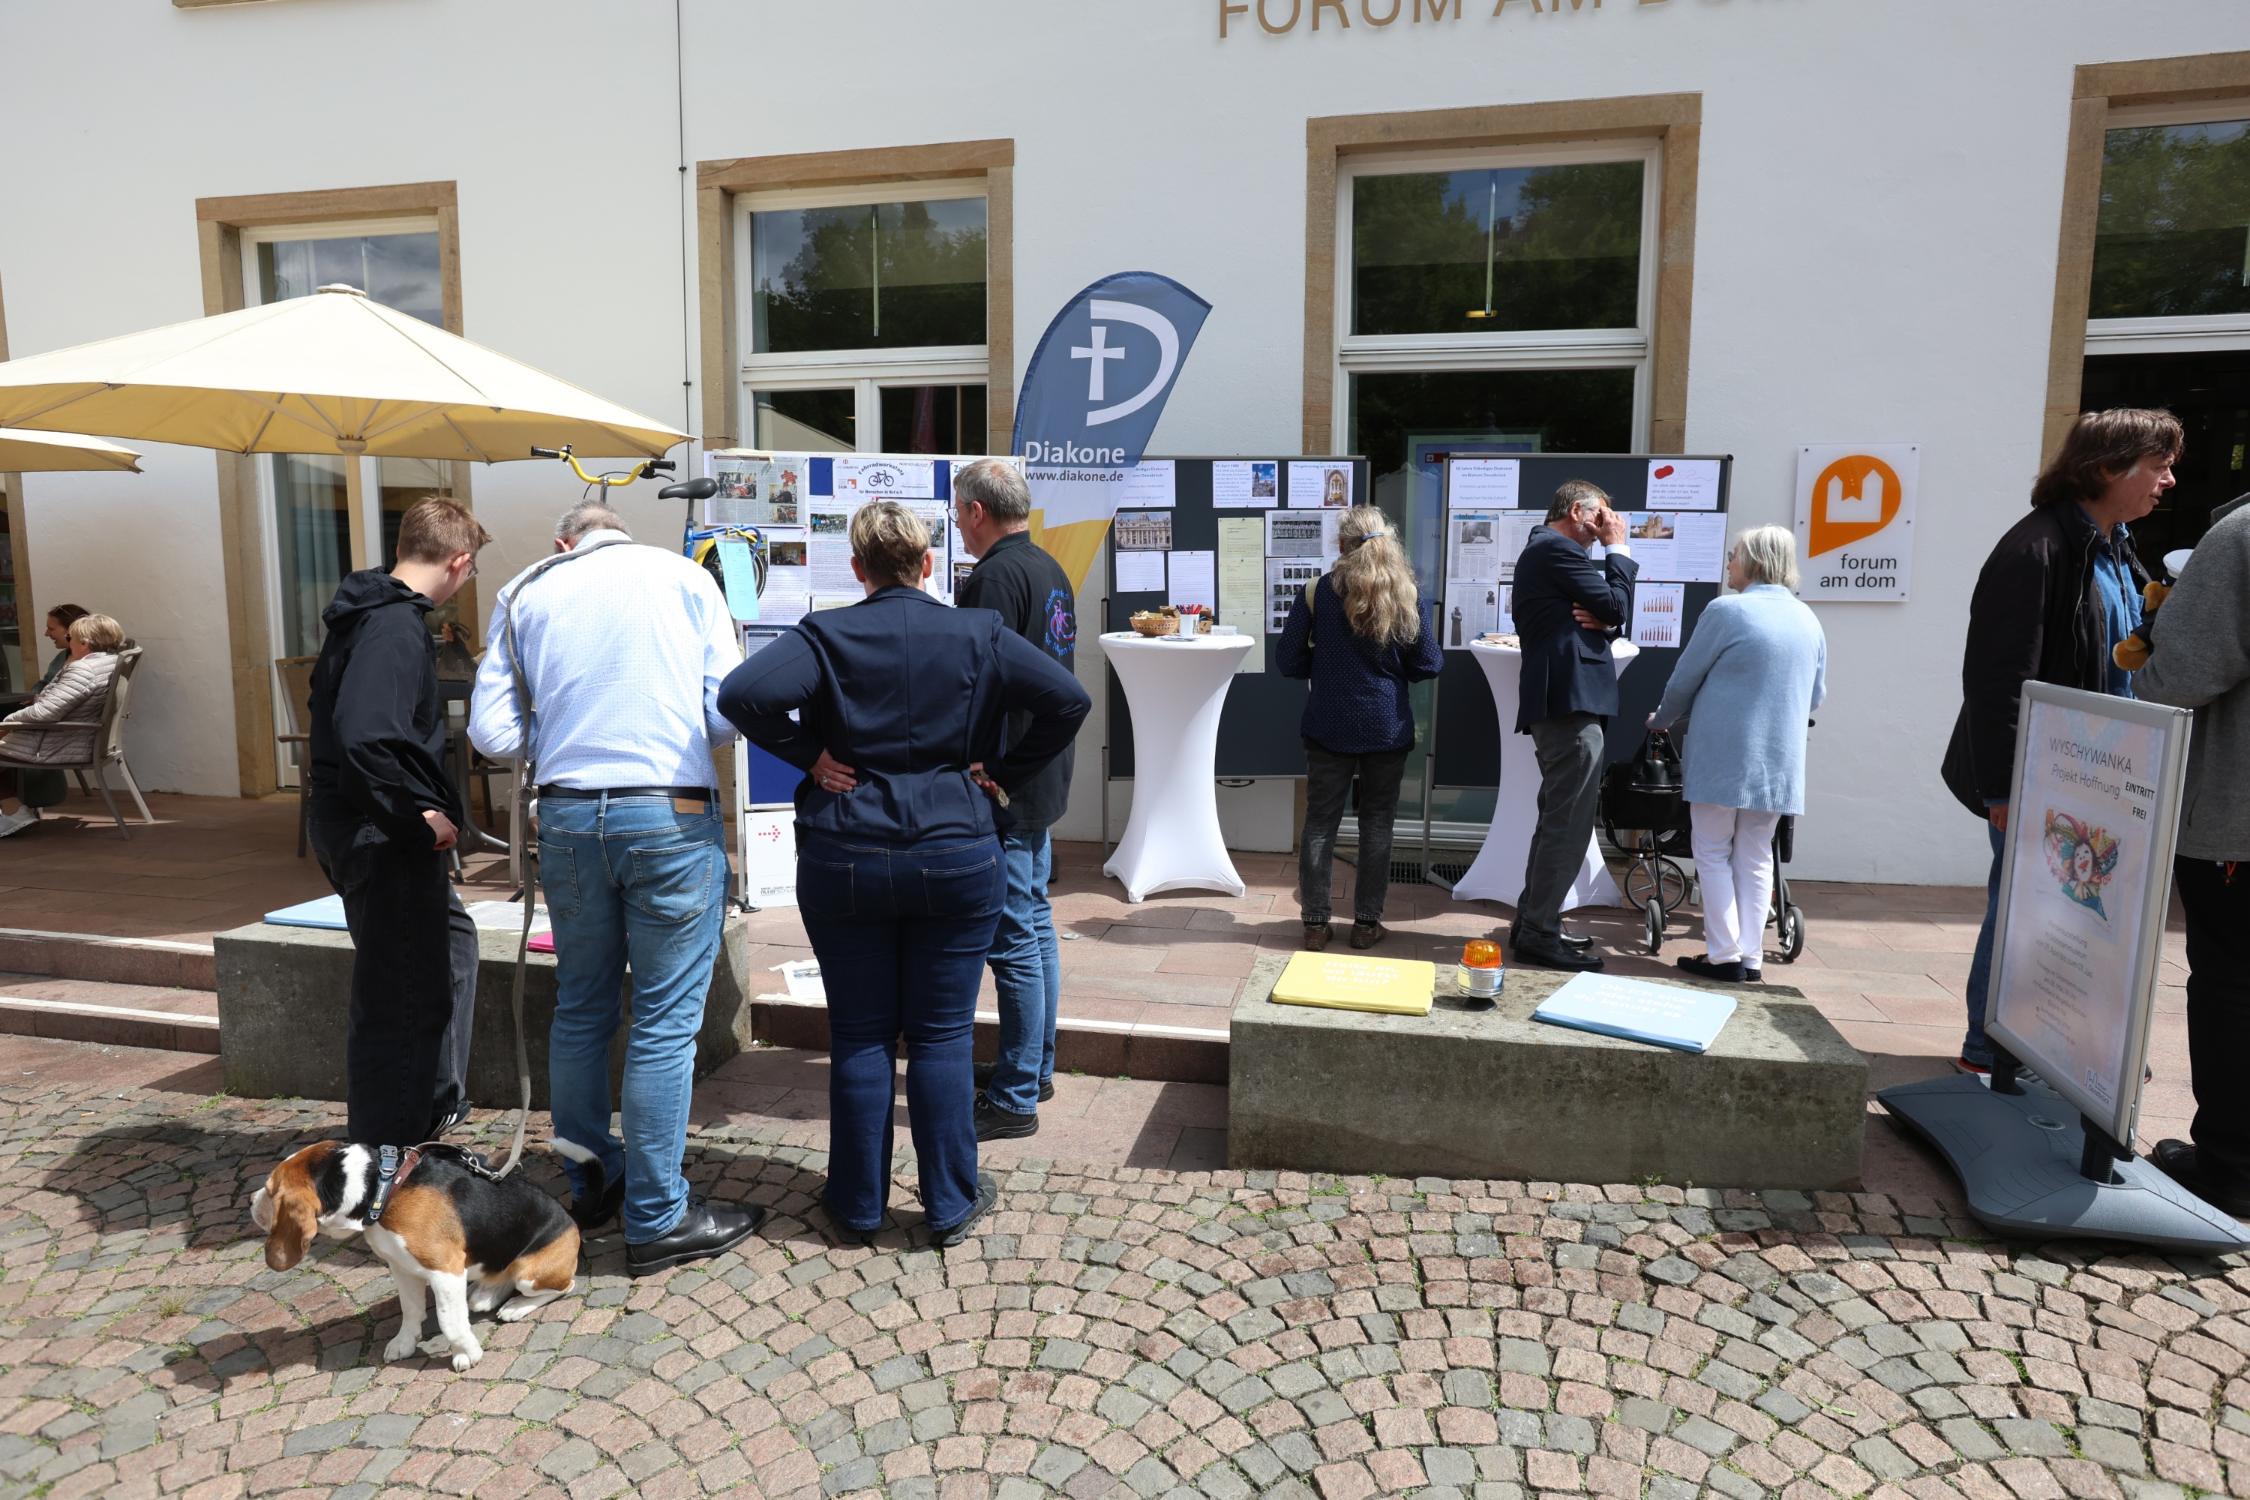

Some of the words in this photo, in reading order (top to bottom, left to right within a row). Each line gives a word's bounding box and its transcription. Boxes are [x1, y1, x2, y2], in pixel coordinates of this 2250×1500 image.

[1025, 441, 1125, 464] Diakone
[1025, 470, 1124, 482] www.diakone.de
[1840, 553, 1897, 570] forum
[1820, 576, 1849, 588] am
[1855, 572, 1896, 588] dom
[2049, 737, 2132, 774] WYSCHYWANKA
[2051, 763, 2078, 784] Projekt
[2079, 772, 2121, 800] Hoffnung
[2125, 781, 2155, 800] EINTRITT
[2132, 806, 2147, 820] FREI
